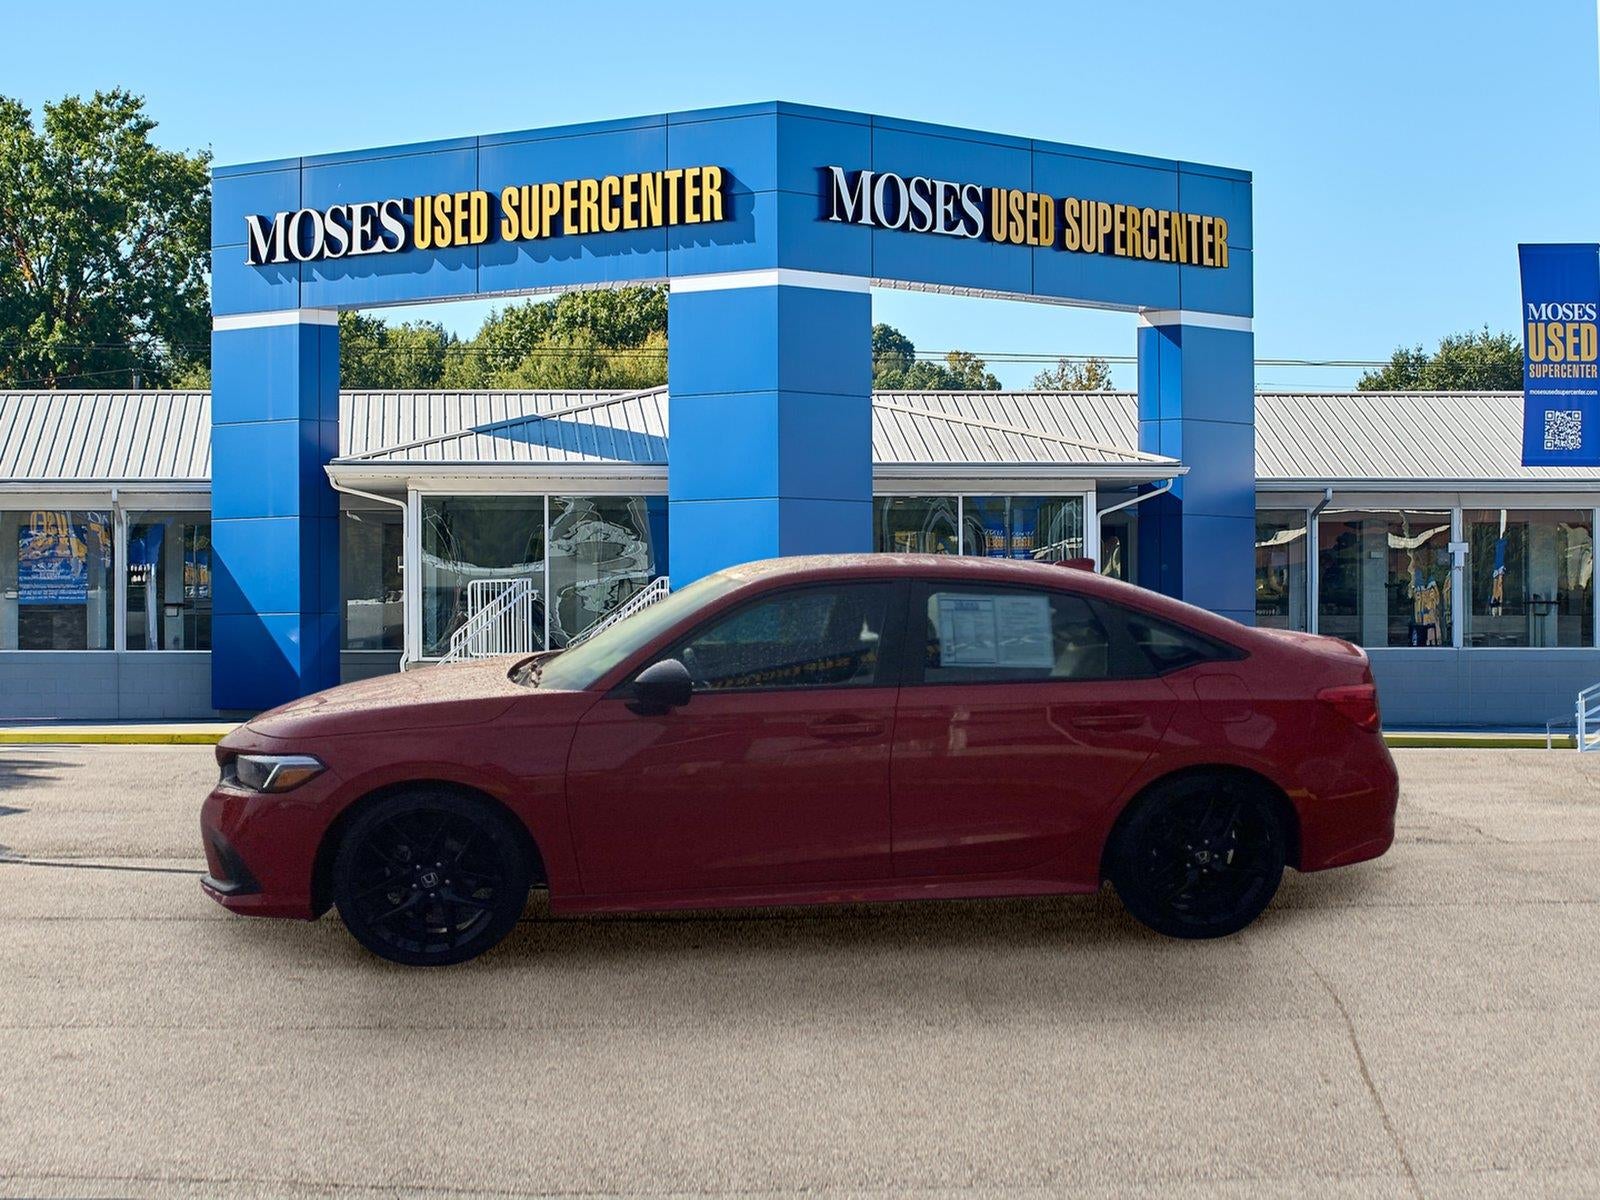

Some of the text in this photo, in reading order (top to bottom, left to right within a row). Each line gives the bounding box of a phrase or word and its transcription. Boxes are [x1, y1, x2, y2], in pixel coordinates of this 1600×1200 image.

[244, 166, 724, 266] MOSES USED SUPERCENTER
[828, 166, 1229, 268] MOSES USED SUPERCENTER
[1527, 303, 1597, 321] MOSES
[1528, 322, 1598, 361] USED
[1529, 363, 1598, 378] SUPERCENTER
